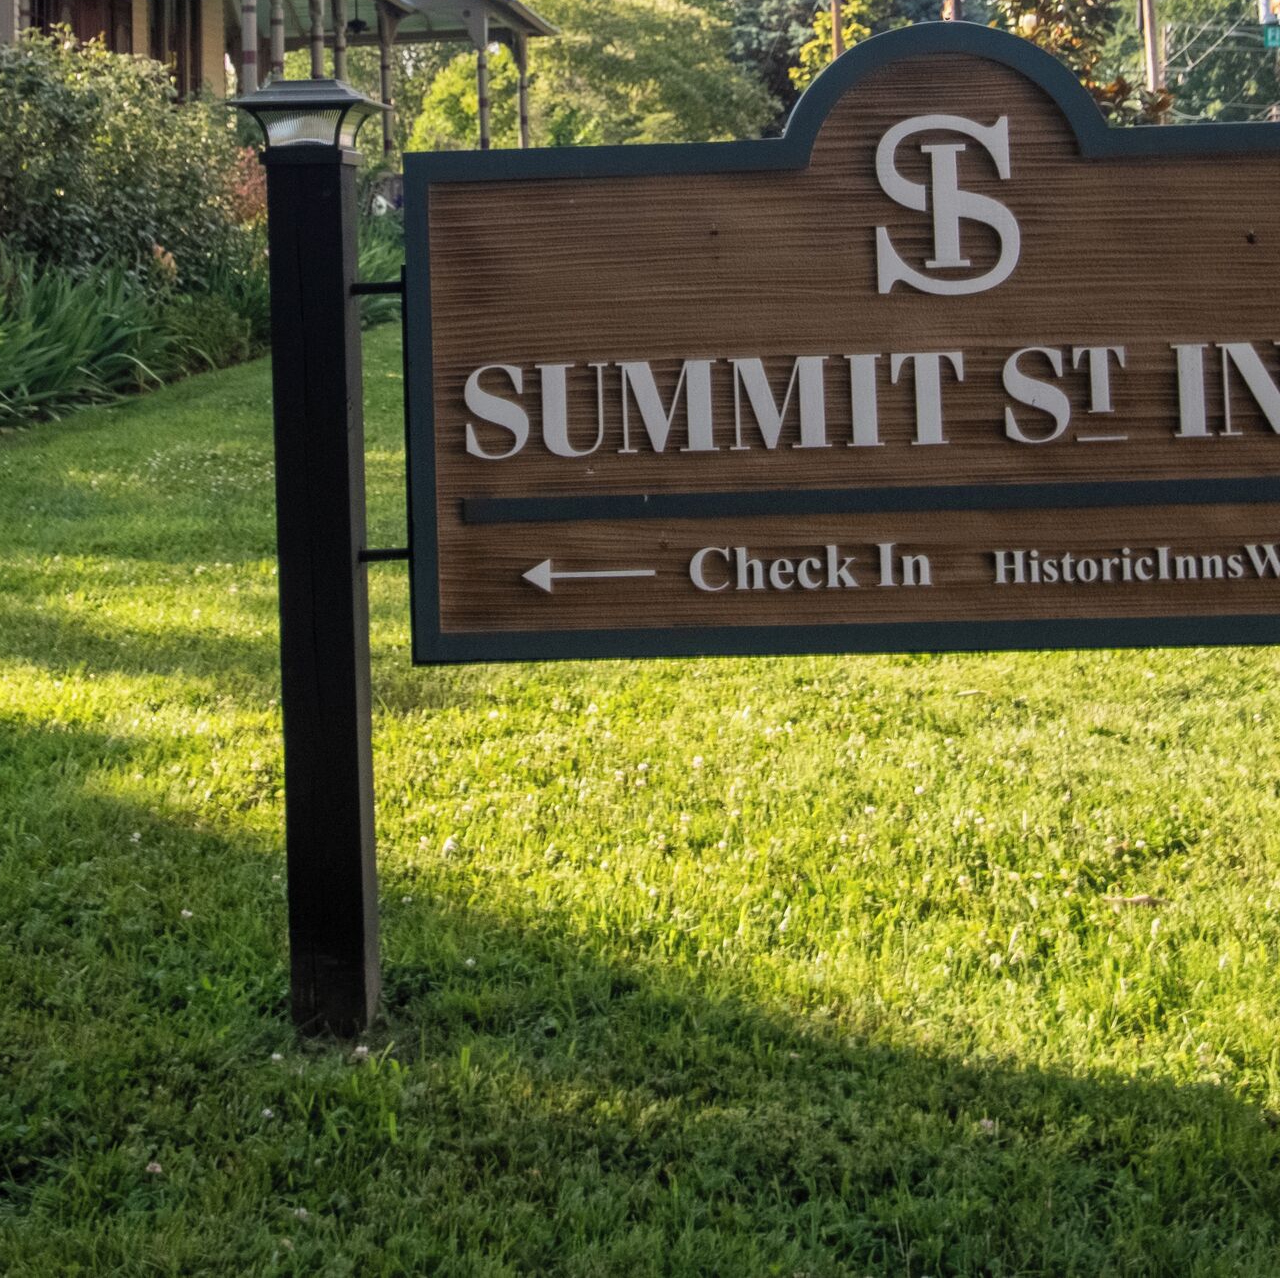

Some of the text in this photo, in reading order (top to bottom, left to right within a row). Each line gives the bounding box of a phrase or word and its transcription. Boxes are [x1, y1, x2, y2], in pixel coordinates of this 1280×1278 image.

[463, 350, 964, 460] SUMMIT
[688, 544, 860, 592] Check
[876, 542, 932, 588] In
